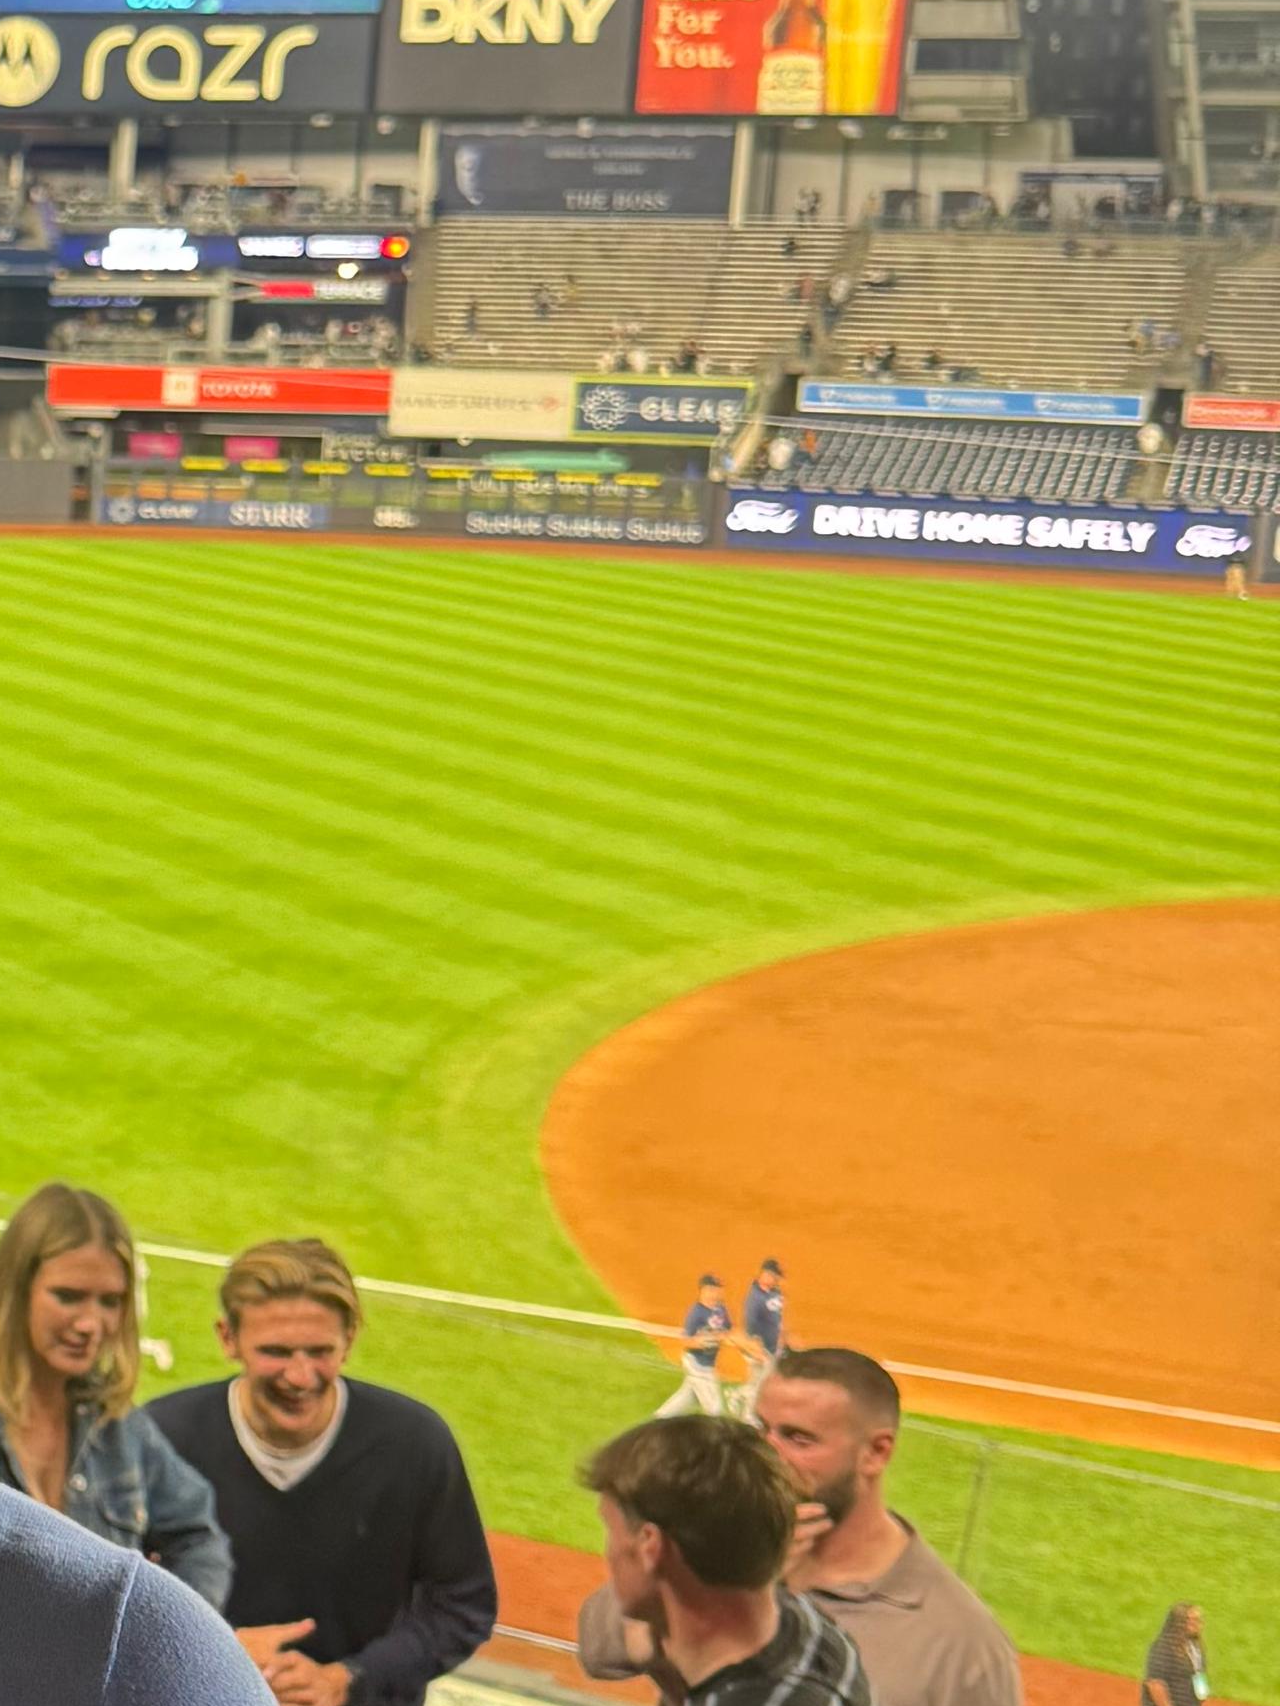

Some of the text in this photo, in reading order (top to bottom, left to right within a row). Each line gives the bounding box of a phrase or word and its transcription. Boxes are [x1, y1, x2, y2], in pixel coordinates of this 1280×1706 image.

[656, 3, 723, 35] For
[81, 24, 319, 102] razr
[652, 36, 737, 70] You.
[563, 188, 672, 212] THE BOSS
[642, 396, 740, 424] CLEAR
[229, 500, 314, 529] STARR
[813, 504, 920, 540] DRIVE
[922, 510, 1024, 546] HOME
[1025, 516, 1158, 554] SAFELY
